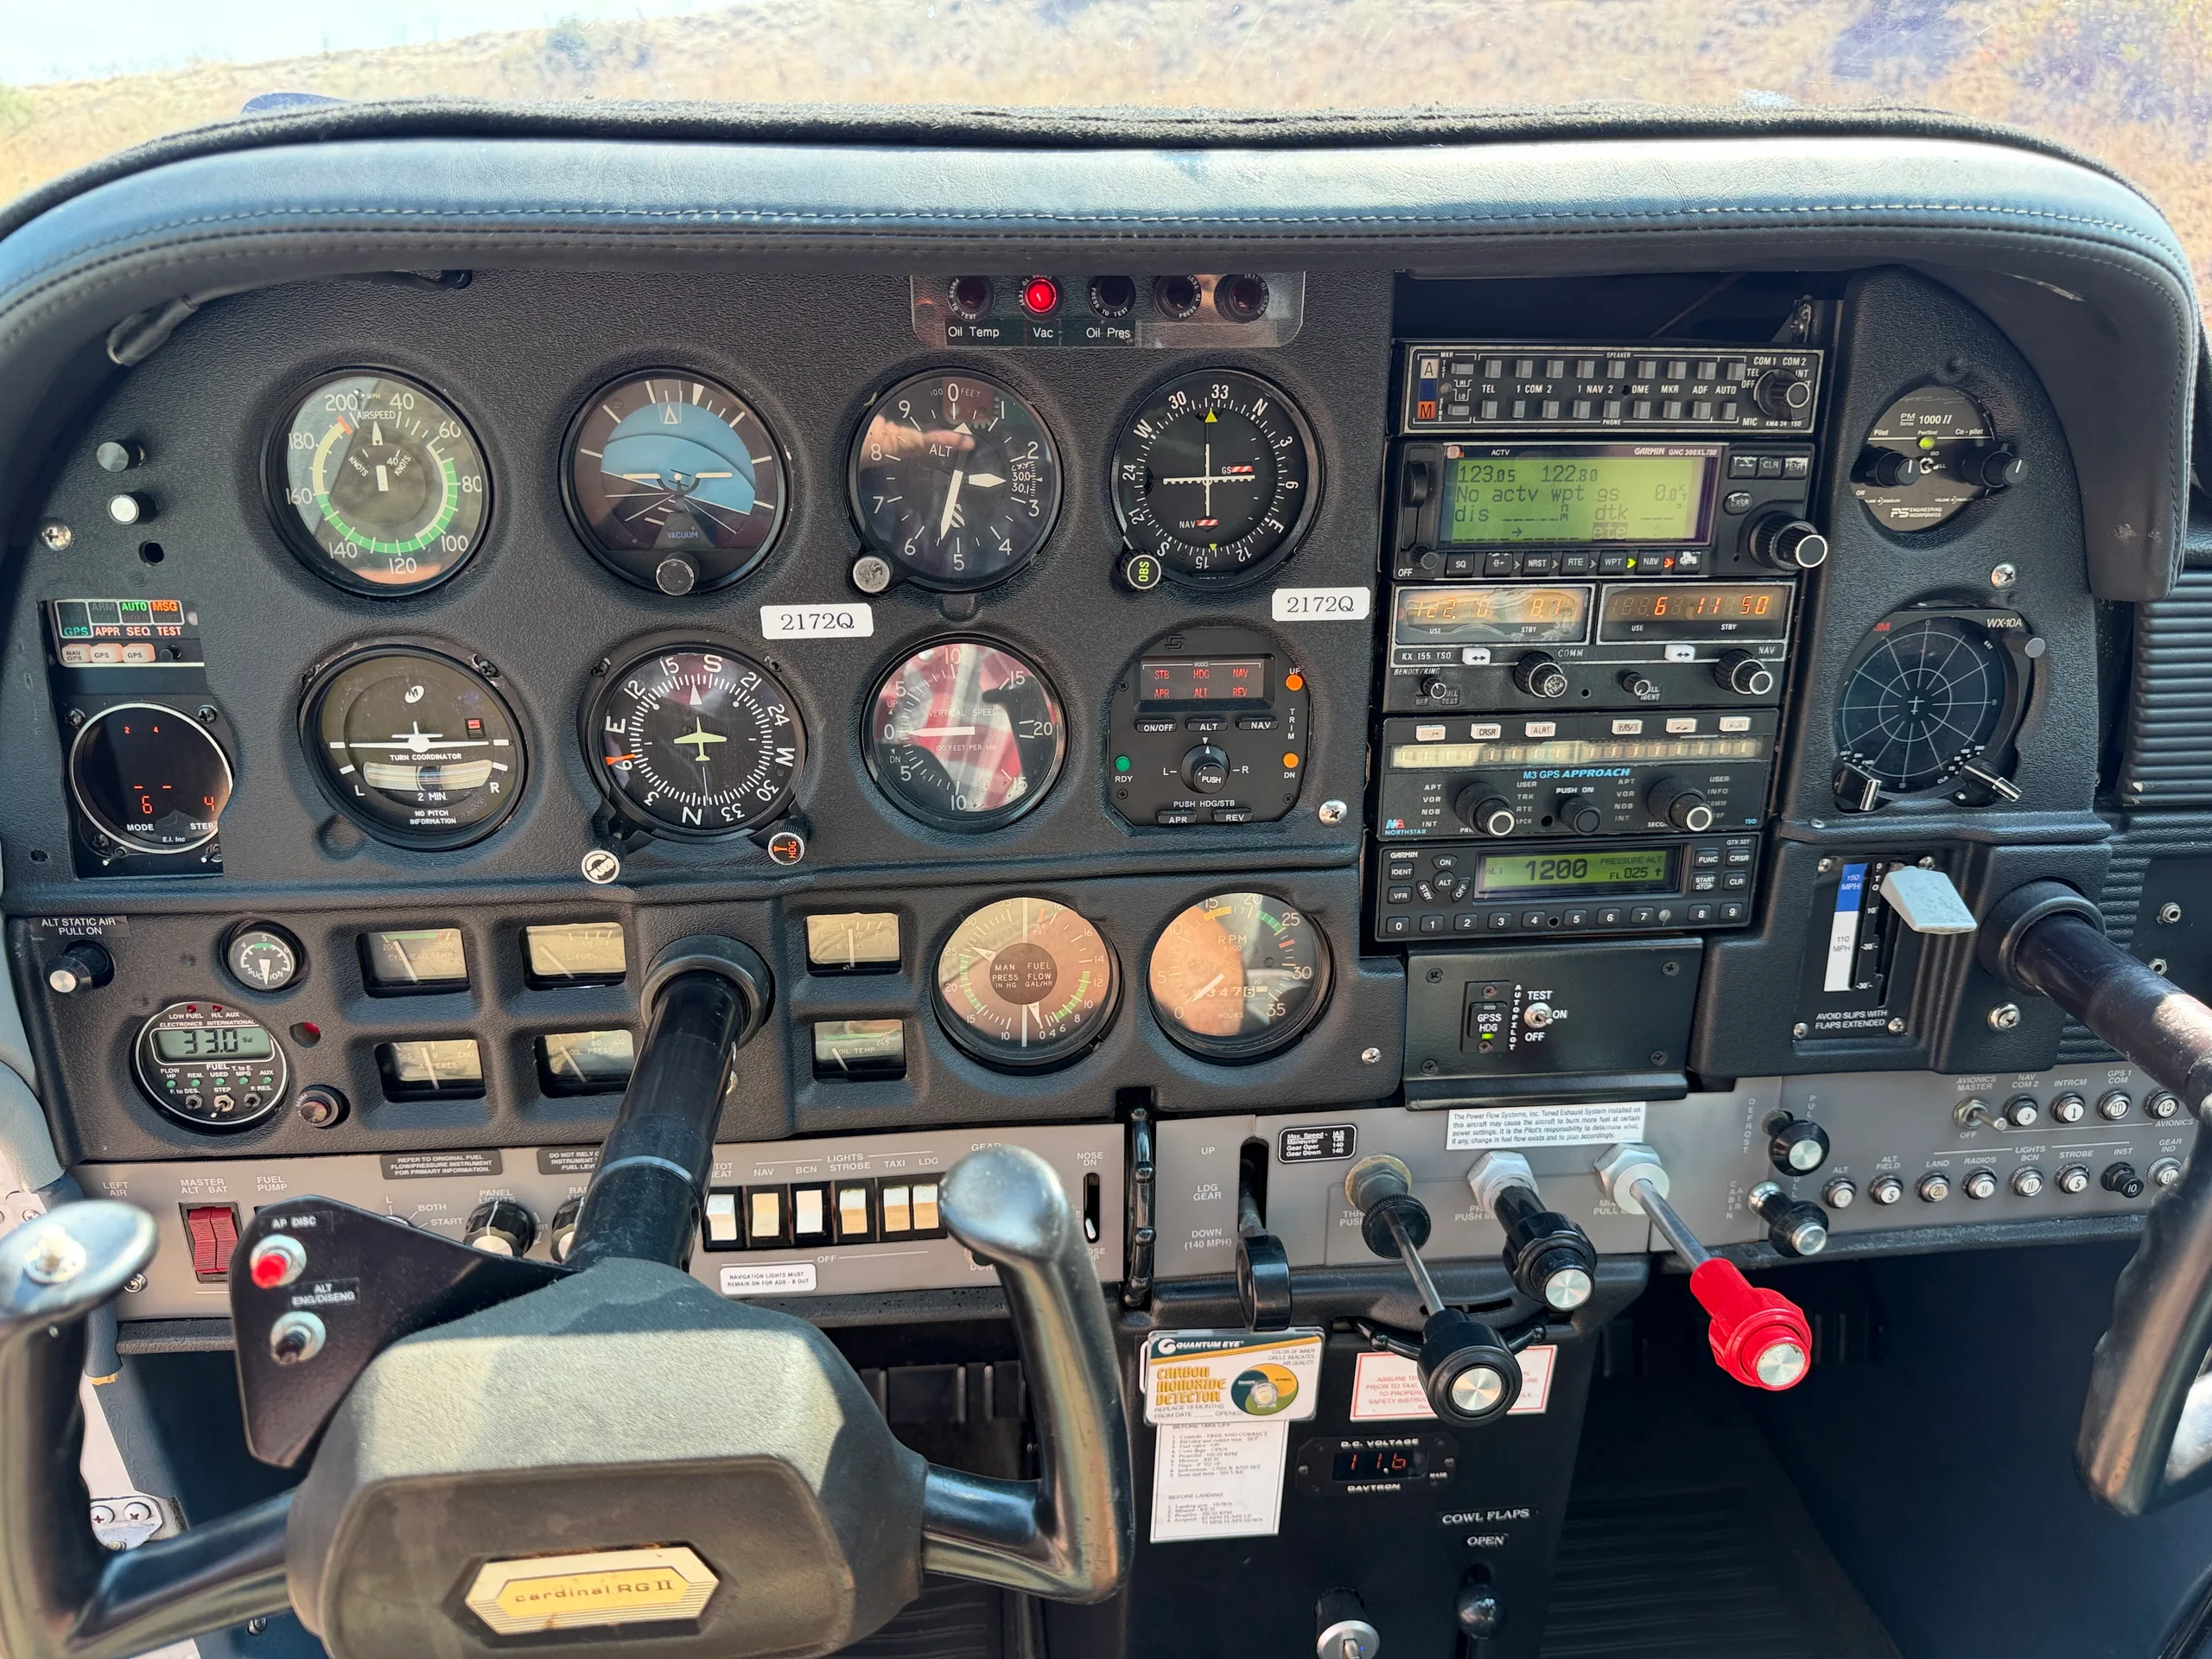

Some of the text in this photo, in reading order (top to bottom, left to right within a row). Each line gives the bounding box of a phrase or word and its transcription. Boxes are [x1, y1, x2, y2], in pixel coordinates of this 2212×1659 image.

[948, 327, 999, 339] Oil Temp
[1033, 327, 1053, 338] Vac
[1086, 327, 1130, 339] Oil Pres
[947, 384, 958, 402] 0
[1211, 385, 1229, 399] 33
[325, 394, 358, 411] 200
[390, 393, 414, 410] 40
[1167, 391, 1187, 410] 30
[1252, 397, 1268, 416] N
[357, 411, 395, 420] AIRSPEED
[1919, 416, 1941, 424] 1000
[439, 421, 461, 438] 60
[289, 433, 315, 449] 180
[929, 445, 952, 457] ALT
[1027, 442, 1039, 459] 2
[1122, 464, 1136, 480] 24
[1459, 465, 1597, 483] 123.05 122.80
[286, 488, 312, 505] 160
[1456, 486, 1584, 506] No actv wpt
[328, 543, 358, 558] 140
[442, 536, 468, 551] 100
[905, 543, 916, 555] 6
[999, 538, 1012, 556] 4
[389, 558, 416, 574] 120
[953, 554, 964, 570] 5
[1138, 561, 1149, 582] OBS
[122, 601, 147, 612] AUTO
[152, 601, 177, 612] MSG
[1287, 596, 1354, 613] 2172Q
[781, 613, 855, 630] 2172Q
[1986, 619, 2022, 627] WX-10A
[64, 626, 181, 636] GPS APPR SEQ TEST
[659, 657, 679, 676] 15
[703, 655, 722, 672] S
[1010, 671, 1026, 685] 15
[1154, 669, 1248, 679] STB HDG NAV
[1154, 688, 1248, 698] APR ALT REV
[606, 715, 626, 734] E
[1033, 721, 1052, 736] 20
[1561, 768, 1630, 778] APPROACH
[682, 806, 702, 825] N
[721, 803, 745, 822] 33
[1525, 858, 1587, 881] 1200
[1624, 868, 1648, 878] 025
[1281, 913, 1300, 925] 25
[59, 927, 84, 936] PULL
[1218, 935, 1247, 944] RPM
[1293, 967, 1312, 979] 30
[1528, 991, 1553, 1001] TEST
[1267, 1003, 1286, 1016] 35
[1552, 1010, 1567, 1019] ON
[1478, 1014, 1502, 1022] GPSS
[1479, 1023, 1497, 1032] HDG
[183, 1029, 238, 1053] 33.0
[1525, 1032, 1545, 1042] OFF
[830, 1162, 871, 1172] STROBE
[1193, 1192, 1222, 1200] GEAR
[271, 1217, 316, 1228] AP DISC
[1192, 1229, 1222, 1237] DOWN
[293, 1292, 354, 1306] ENG/DISENG
[1157, 1366, 1210, 1379] CARBON
[1157, 1378, 1226, 1392] MONOXIDE
[1156, 1391, 1221, 1405] DETECTOR
[1367, 1438, 1419, 1447] VOLTAGE
[1442, 1509, 1529, 1524] COWL FLAPS
[1467, 1536, 1503, 1547] OPEN
[515, 1580, 673, 1603] cardinal RG II
